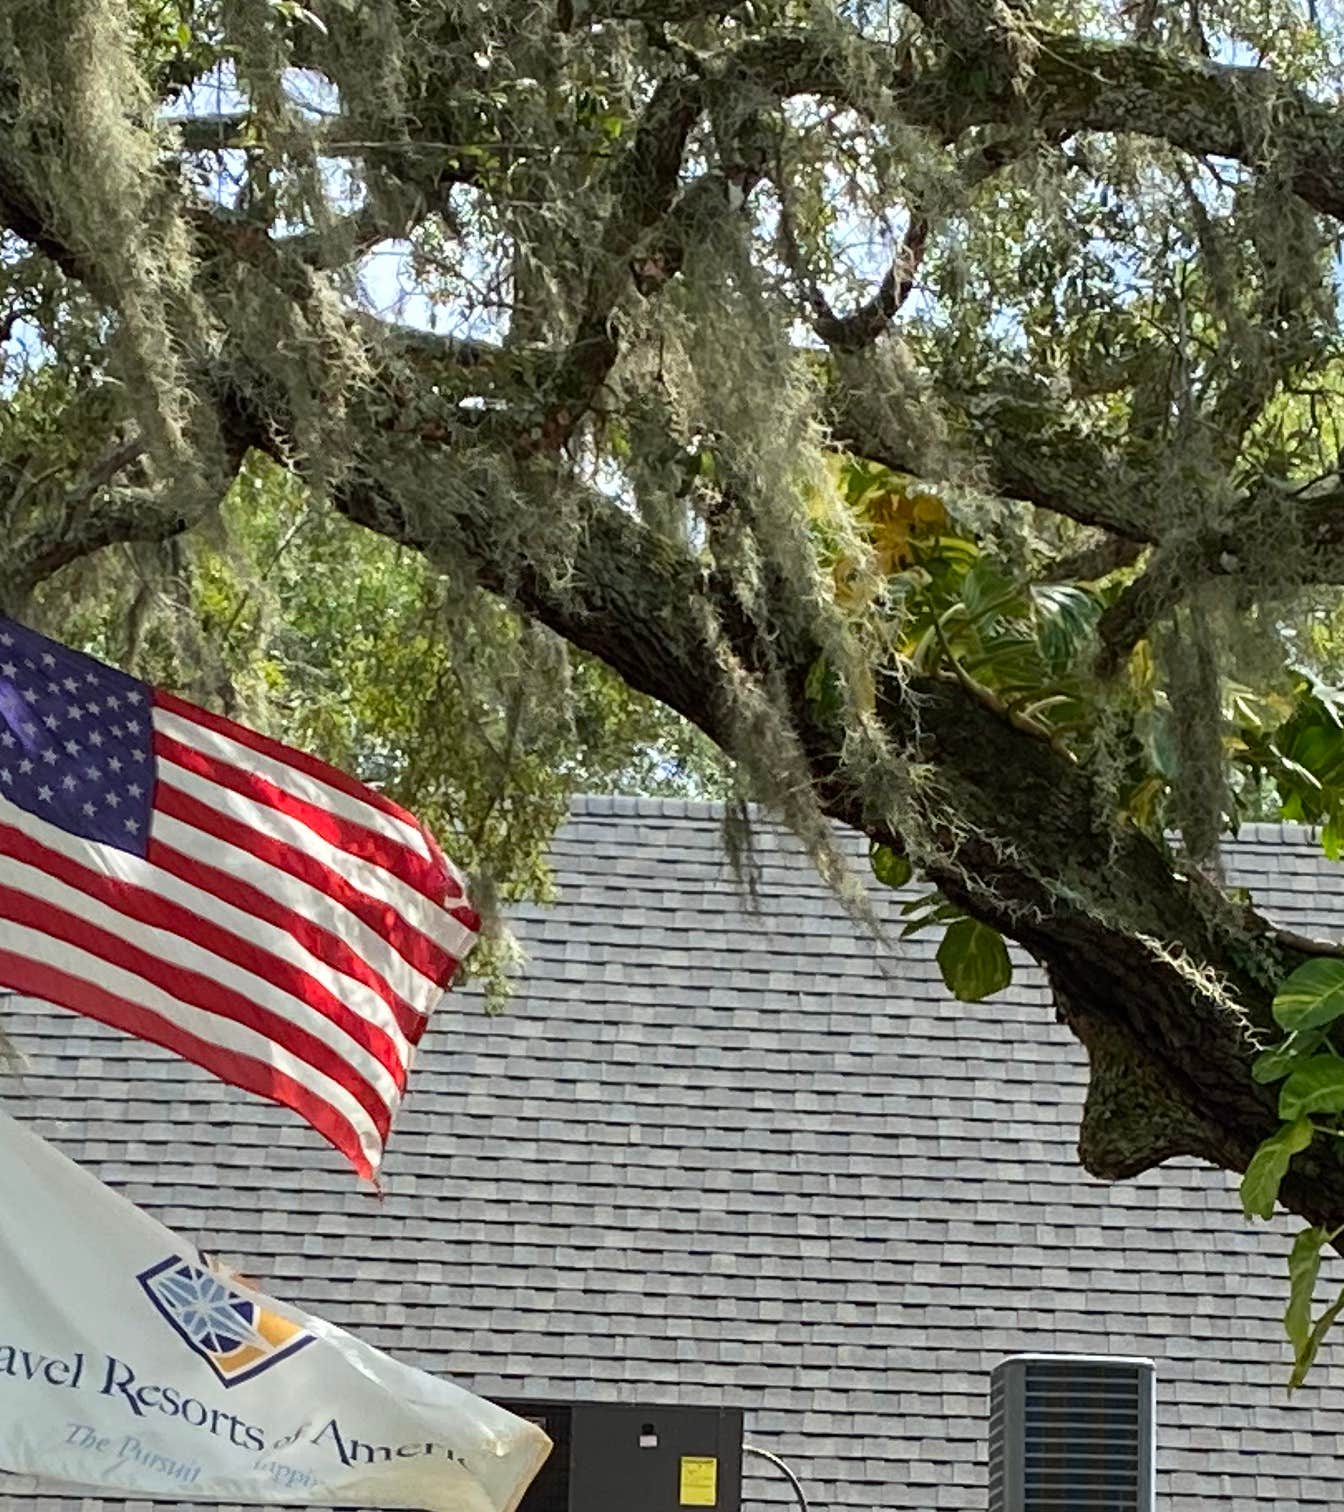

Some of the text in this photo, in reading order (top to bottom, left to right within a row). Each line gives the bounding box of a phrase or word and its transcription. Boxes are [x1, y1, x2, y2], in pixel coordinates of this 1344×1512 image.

[99, 1355, 265, 1452] Resorts
[64, 1422, 203, 1484] The Pursuit
